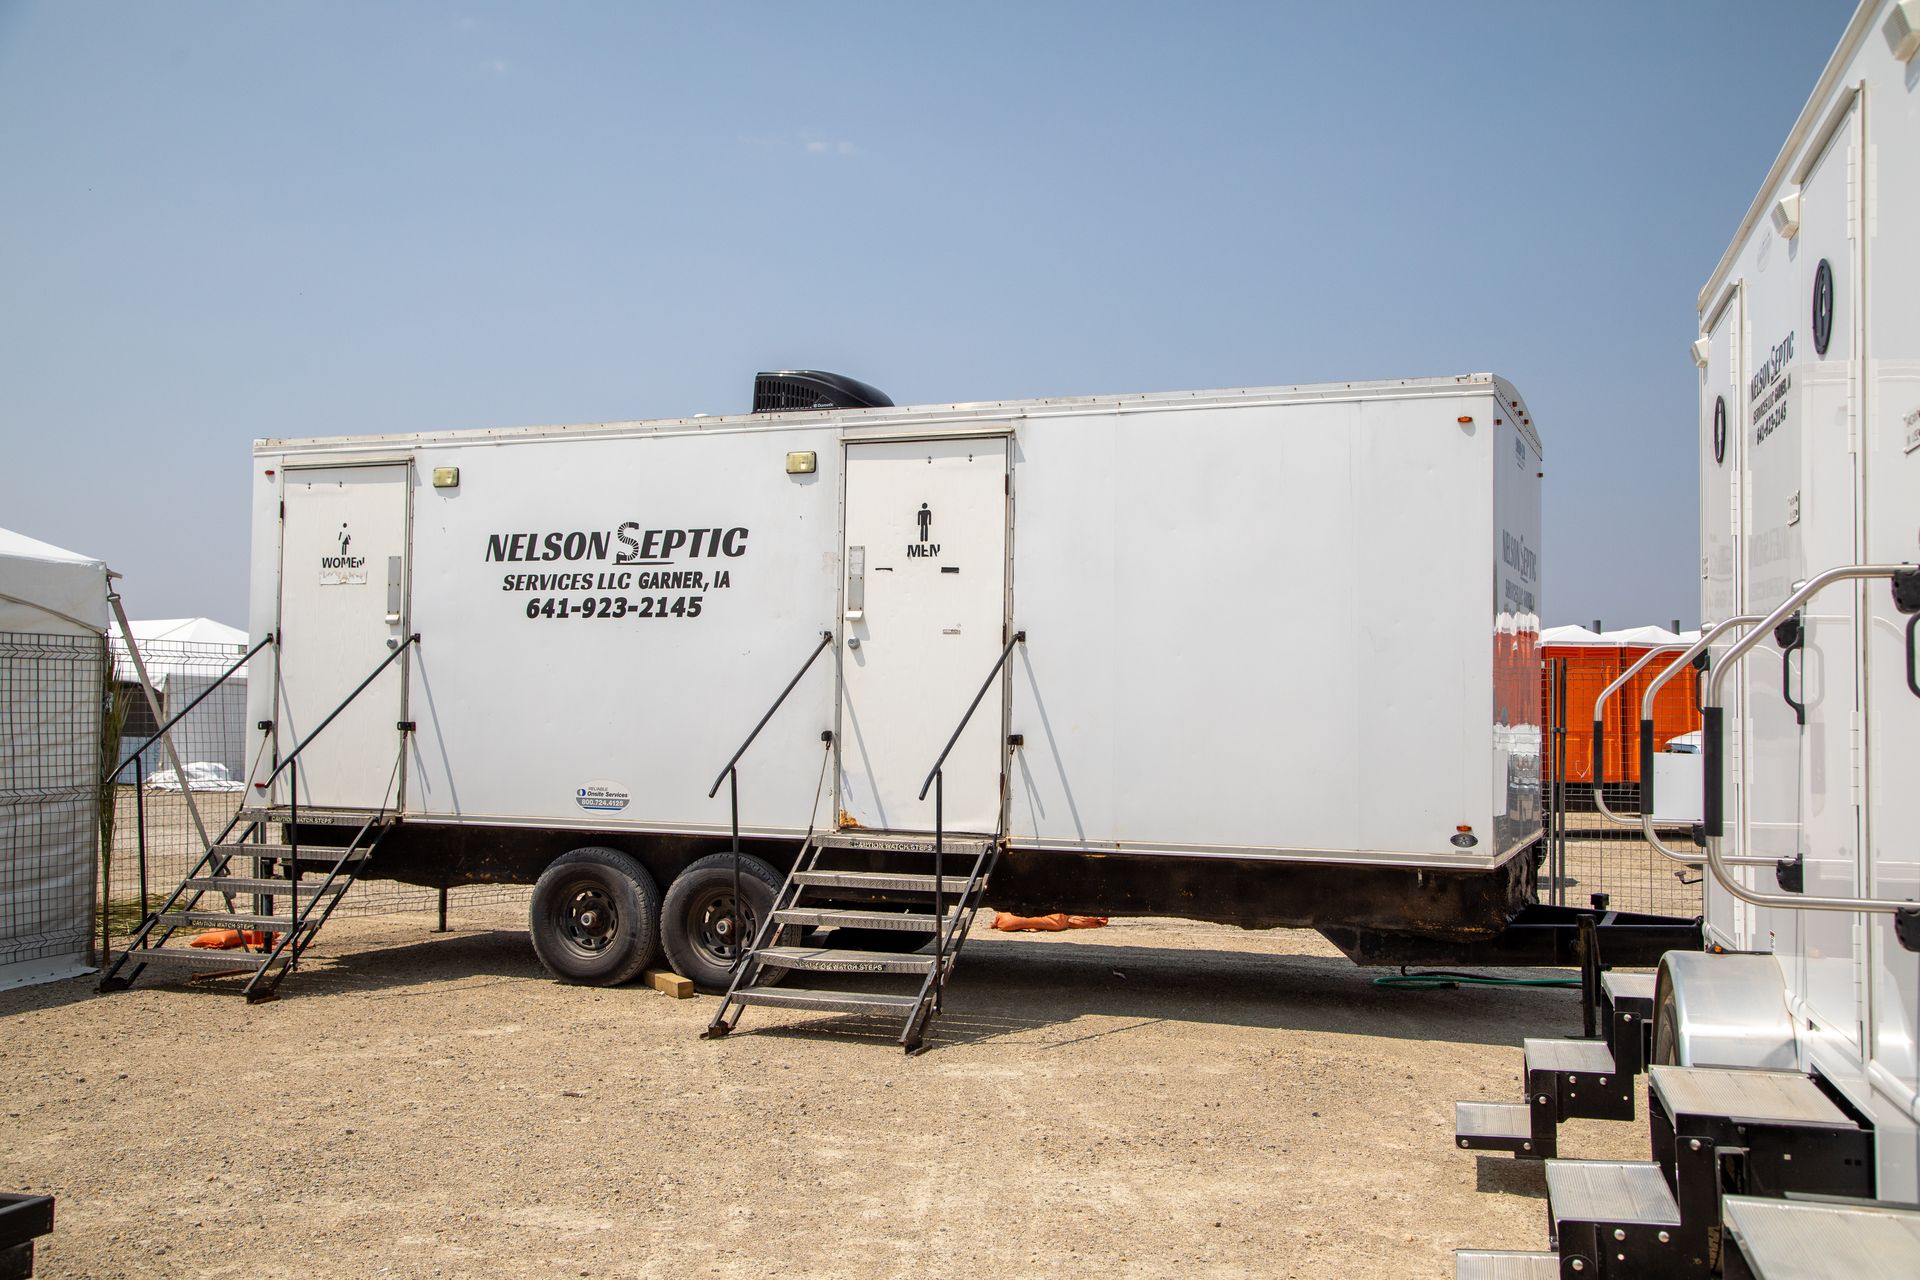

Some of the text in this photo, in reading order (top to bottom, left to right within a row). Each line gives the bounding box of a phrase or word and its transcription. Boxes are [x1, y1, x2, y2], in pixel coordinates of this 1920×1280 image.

[1751, 330, 1794, 402] NELSON SEPTIC
[485, 521, 749, 562] NELSON SEPTIC
[906, 544, 941, 558] MEN
[321, 556, 366, 569] WOMEN
[502, 570, 731, 592] SERVICES LLC GARNER, IA
[526, 596, 704, 619] 641-923-2145
